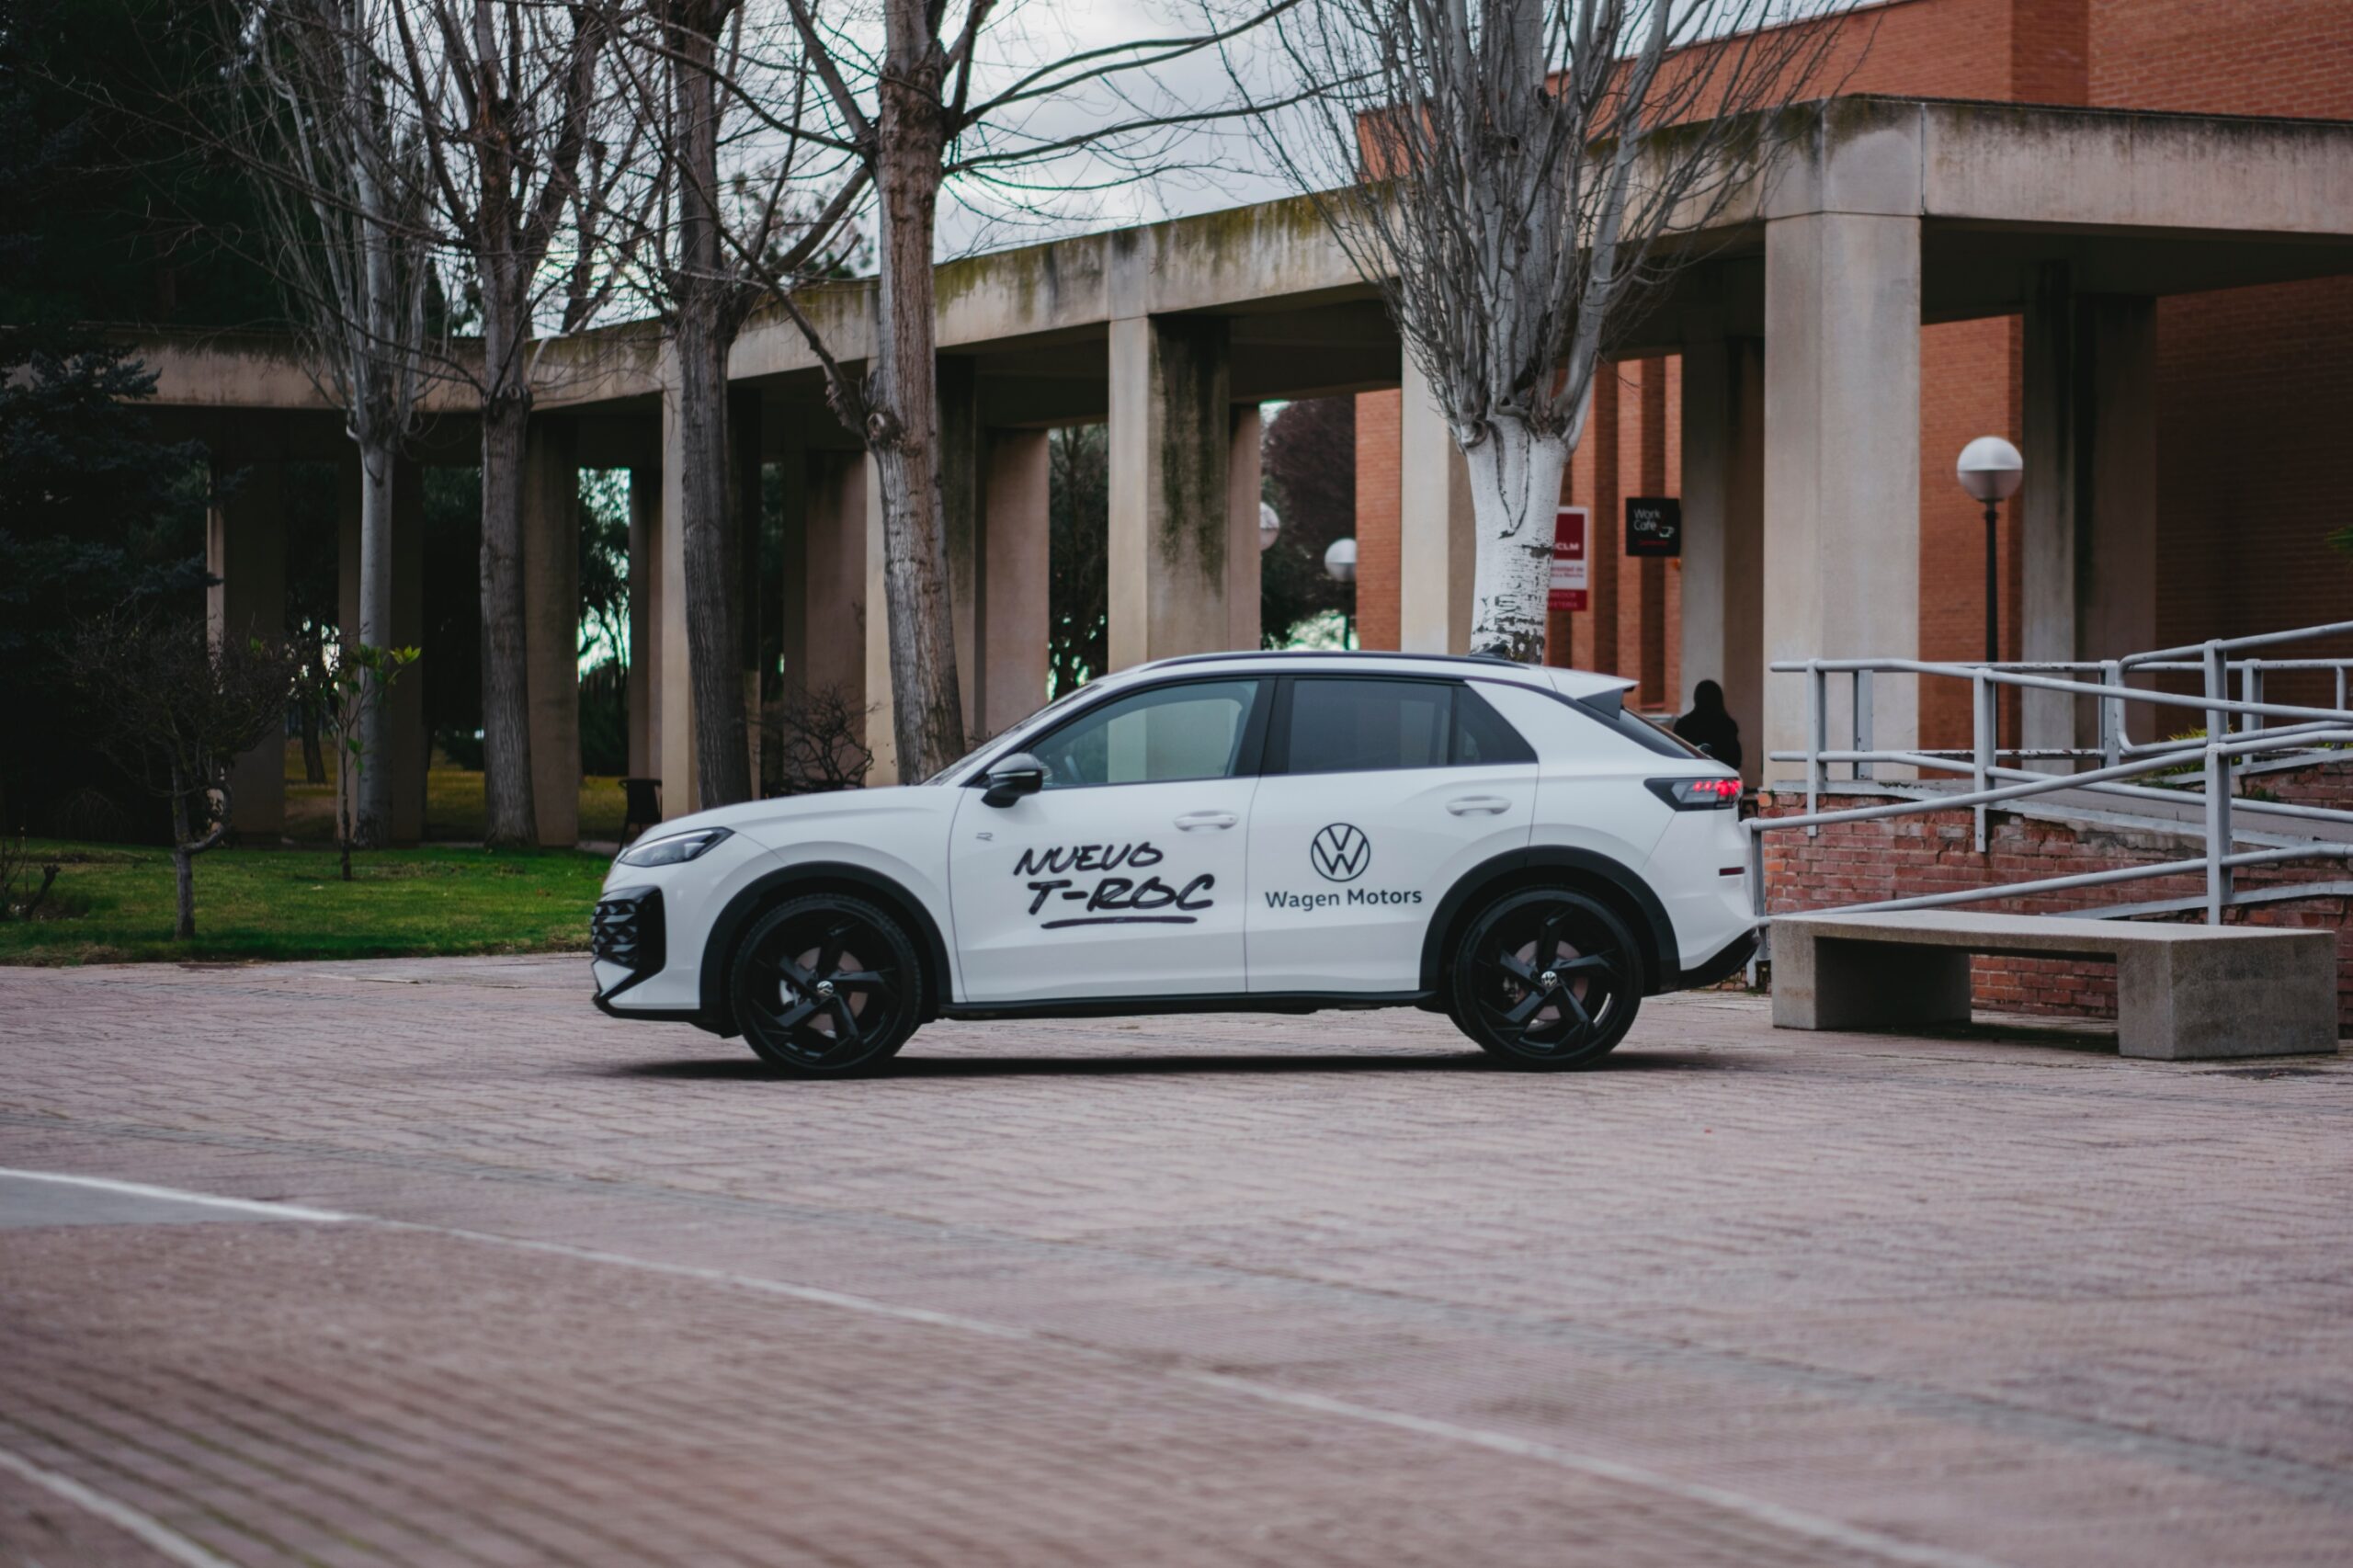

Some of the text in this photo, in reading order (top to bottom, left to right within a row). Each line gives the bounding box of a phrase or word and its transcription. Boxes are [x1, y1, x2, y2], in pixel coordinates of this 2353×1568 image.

[1633, 508, 1661, 519] Work
[1555, 542, 1579, 551] CLM
[1013, 841, 1164, 877] NUEVO
[1027, 873, 1216, 916] T-ROC
[1265, 888, 1423, 912] Wagen Motors
